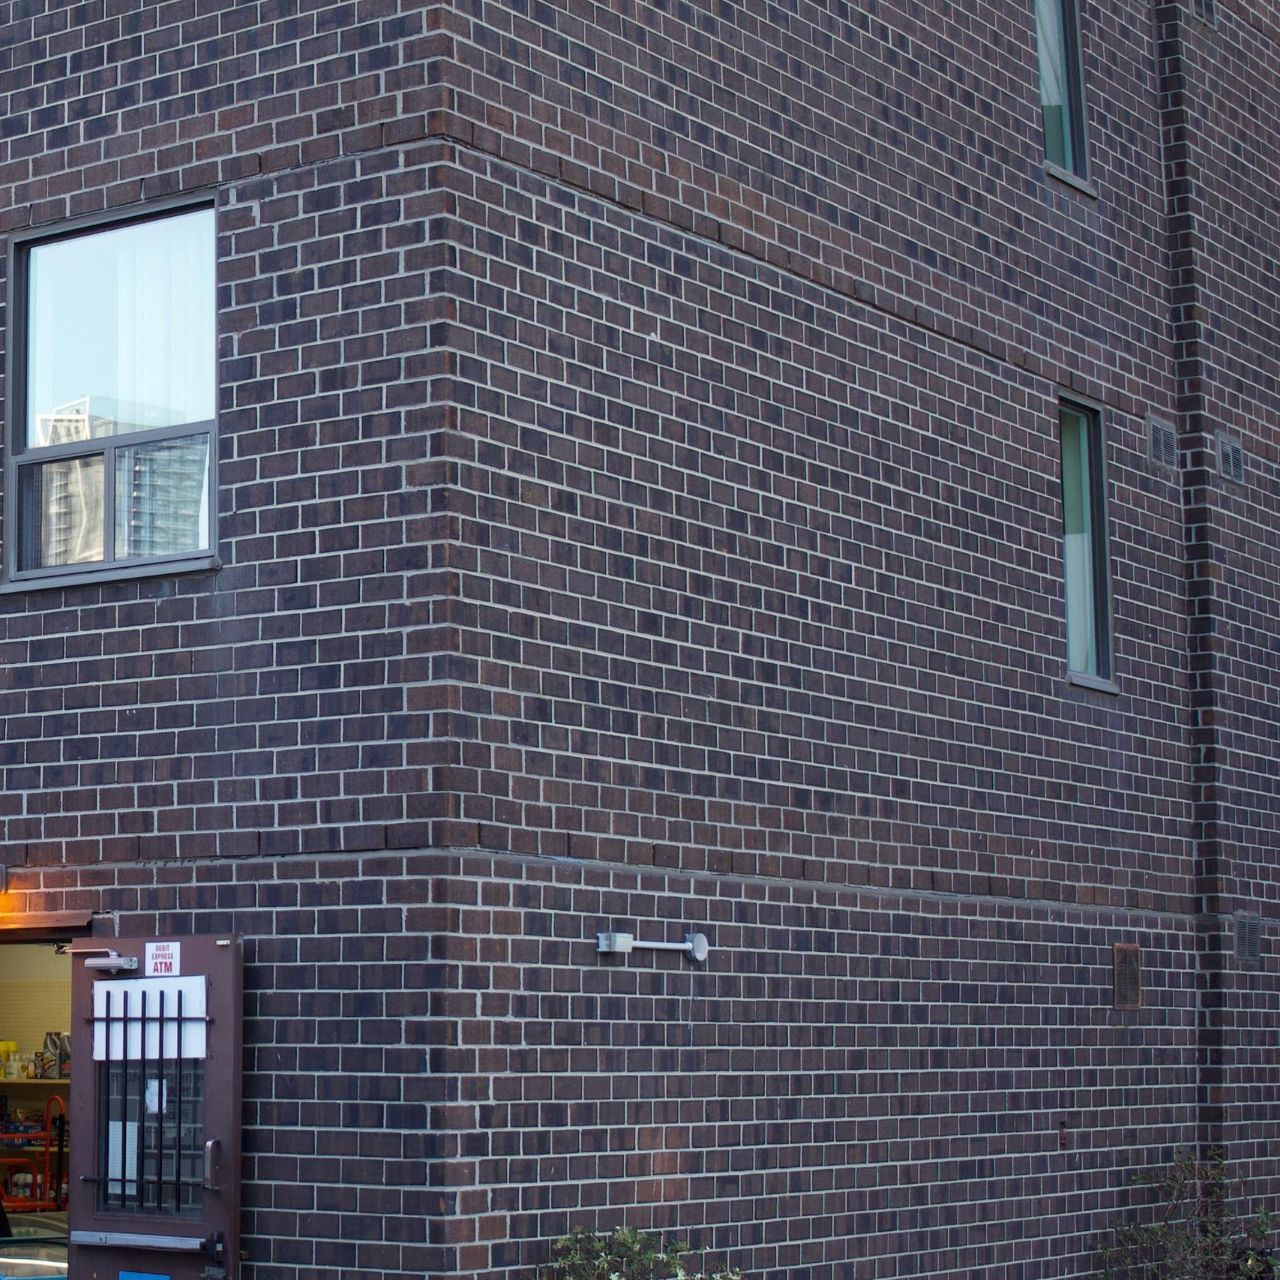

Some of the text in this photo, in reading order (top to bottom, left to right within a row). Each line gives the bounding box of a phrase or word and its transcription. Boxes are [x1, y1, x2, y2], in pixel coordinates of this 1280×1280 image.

[155, 944, 170, 952] DEBIT
[151, 952, 174, 960] EXPRESS
[153, 961, 173, 973] ATM
